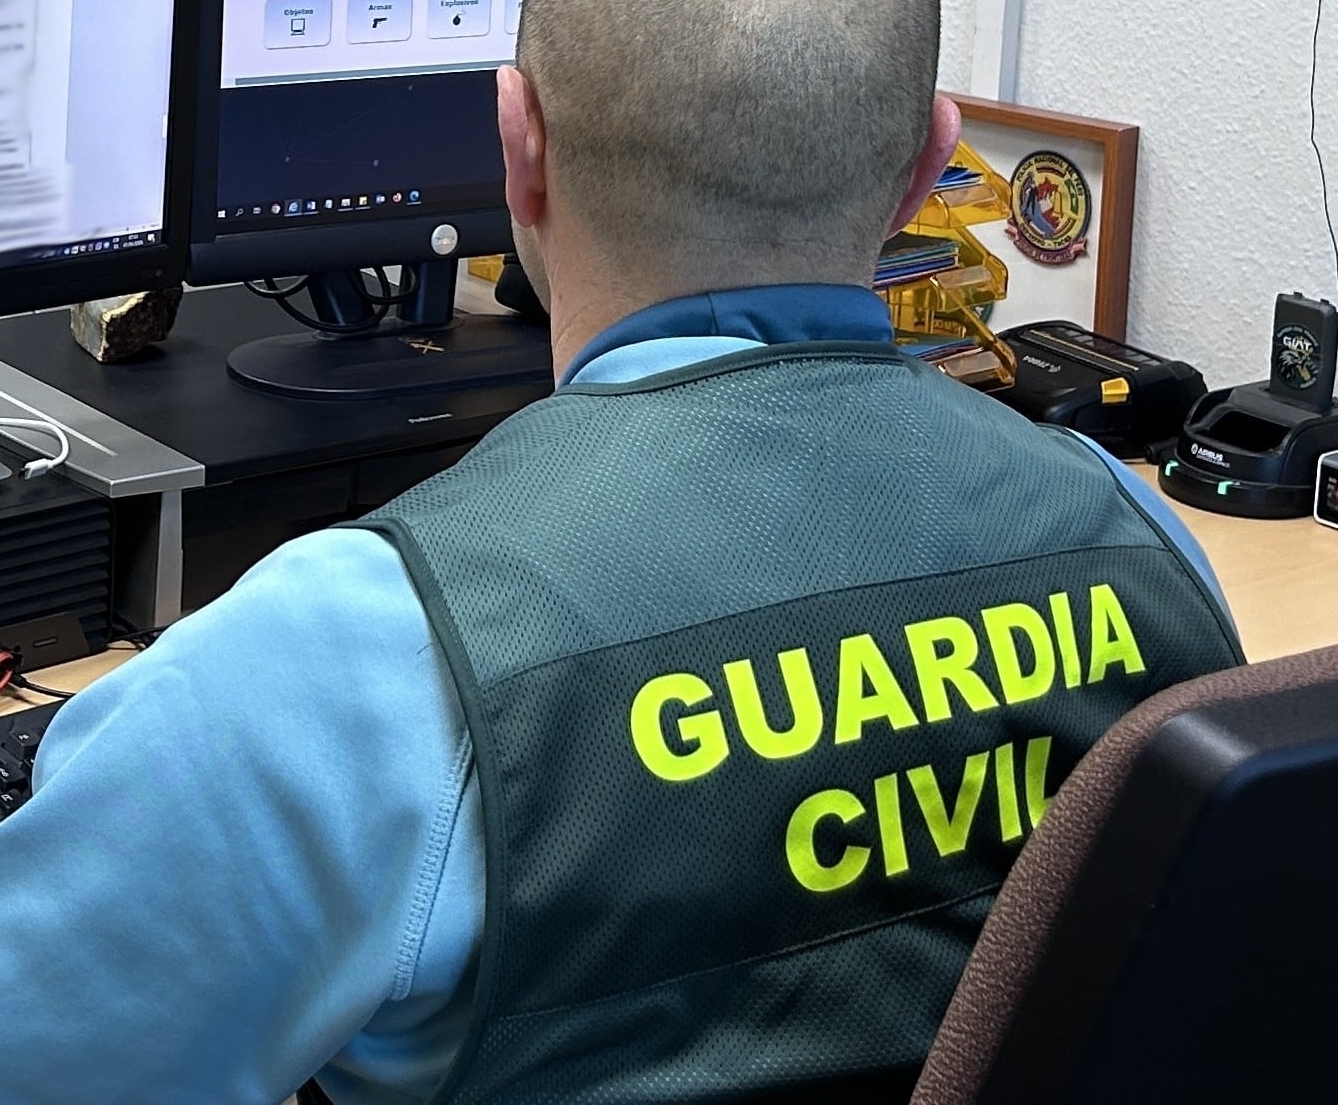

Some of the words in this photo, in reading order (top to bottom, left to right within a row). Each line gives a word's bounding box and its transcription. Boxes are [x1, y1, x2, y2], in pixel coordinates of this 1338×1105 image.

[284, 8, 314, 16] Objetos
[440, 0, 479, 8] Explosivos
[629, 583, 1146, 783] GUARDIA
[785, 736, 1058, 892] CIVIL
